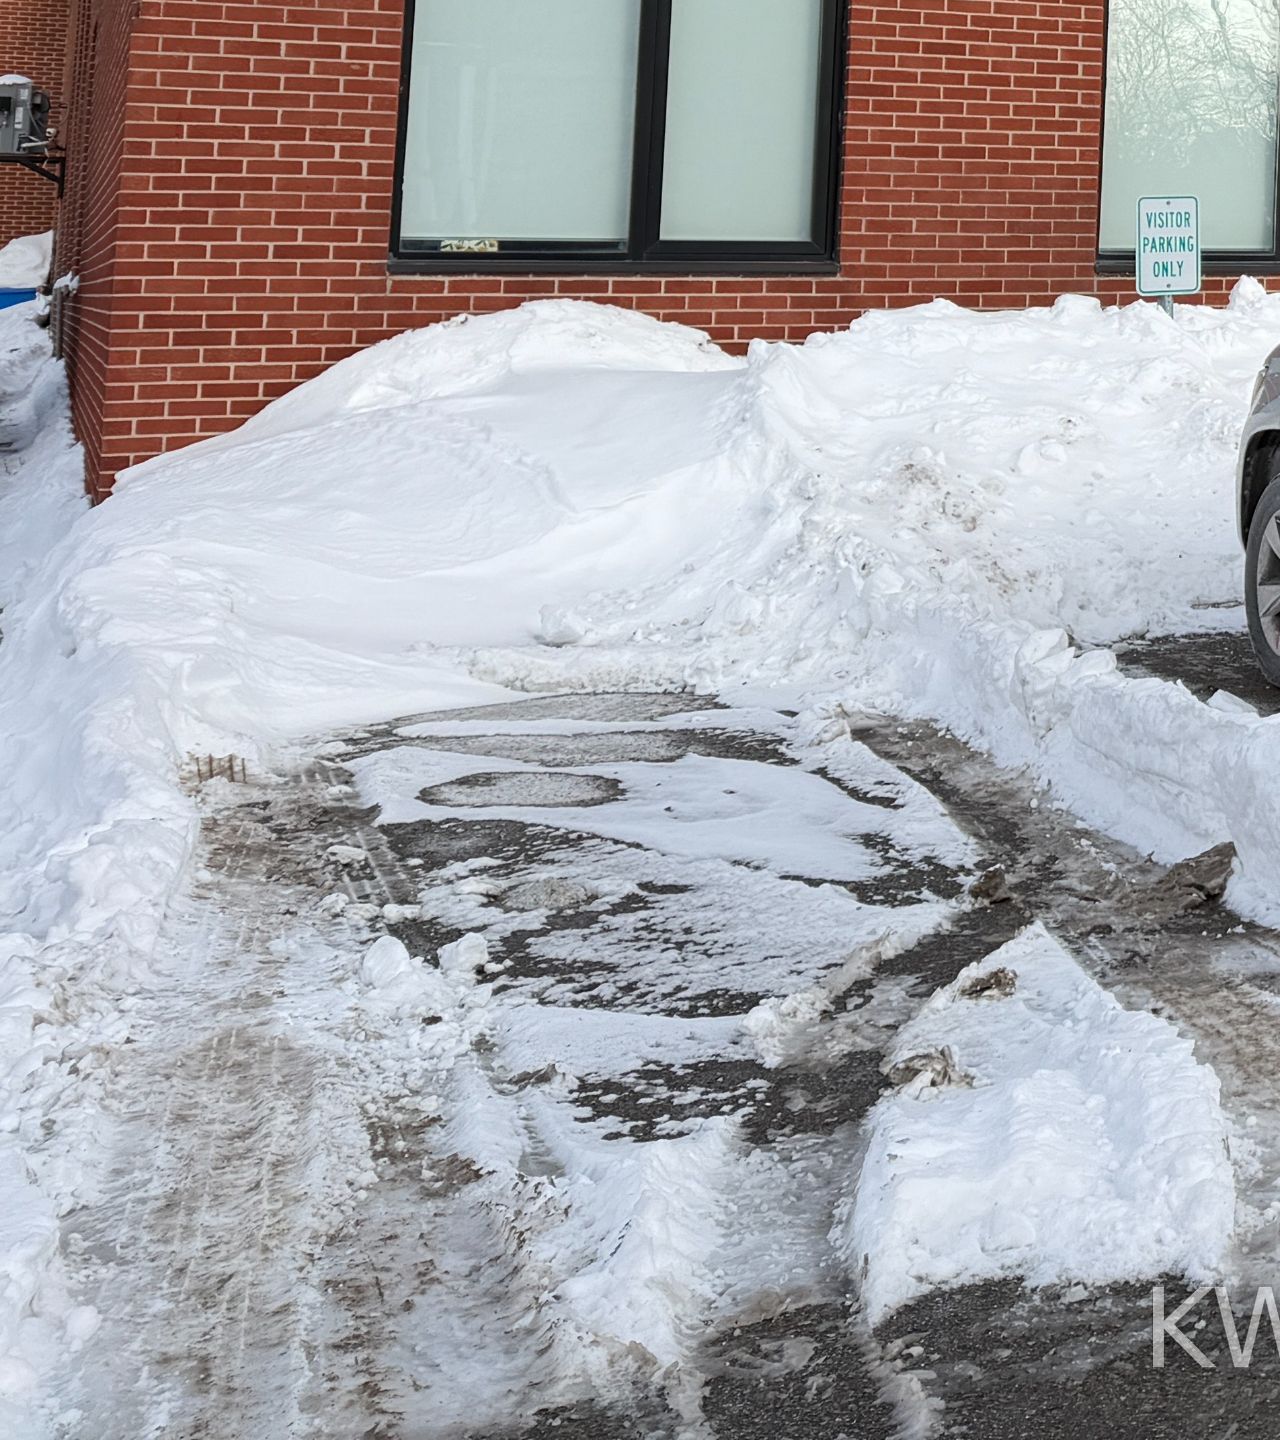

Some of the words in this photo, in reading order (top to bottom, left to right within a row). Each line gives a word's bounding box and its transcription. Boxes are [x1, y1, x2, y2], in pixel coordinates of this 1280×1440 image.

[1145, 211, 1191, 229] VISITOR
[1142, 235, 1194, 254] PARKING
[1152, 260, 1184, 278] ONLY
